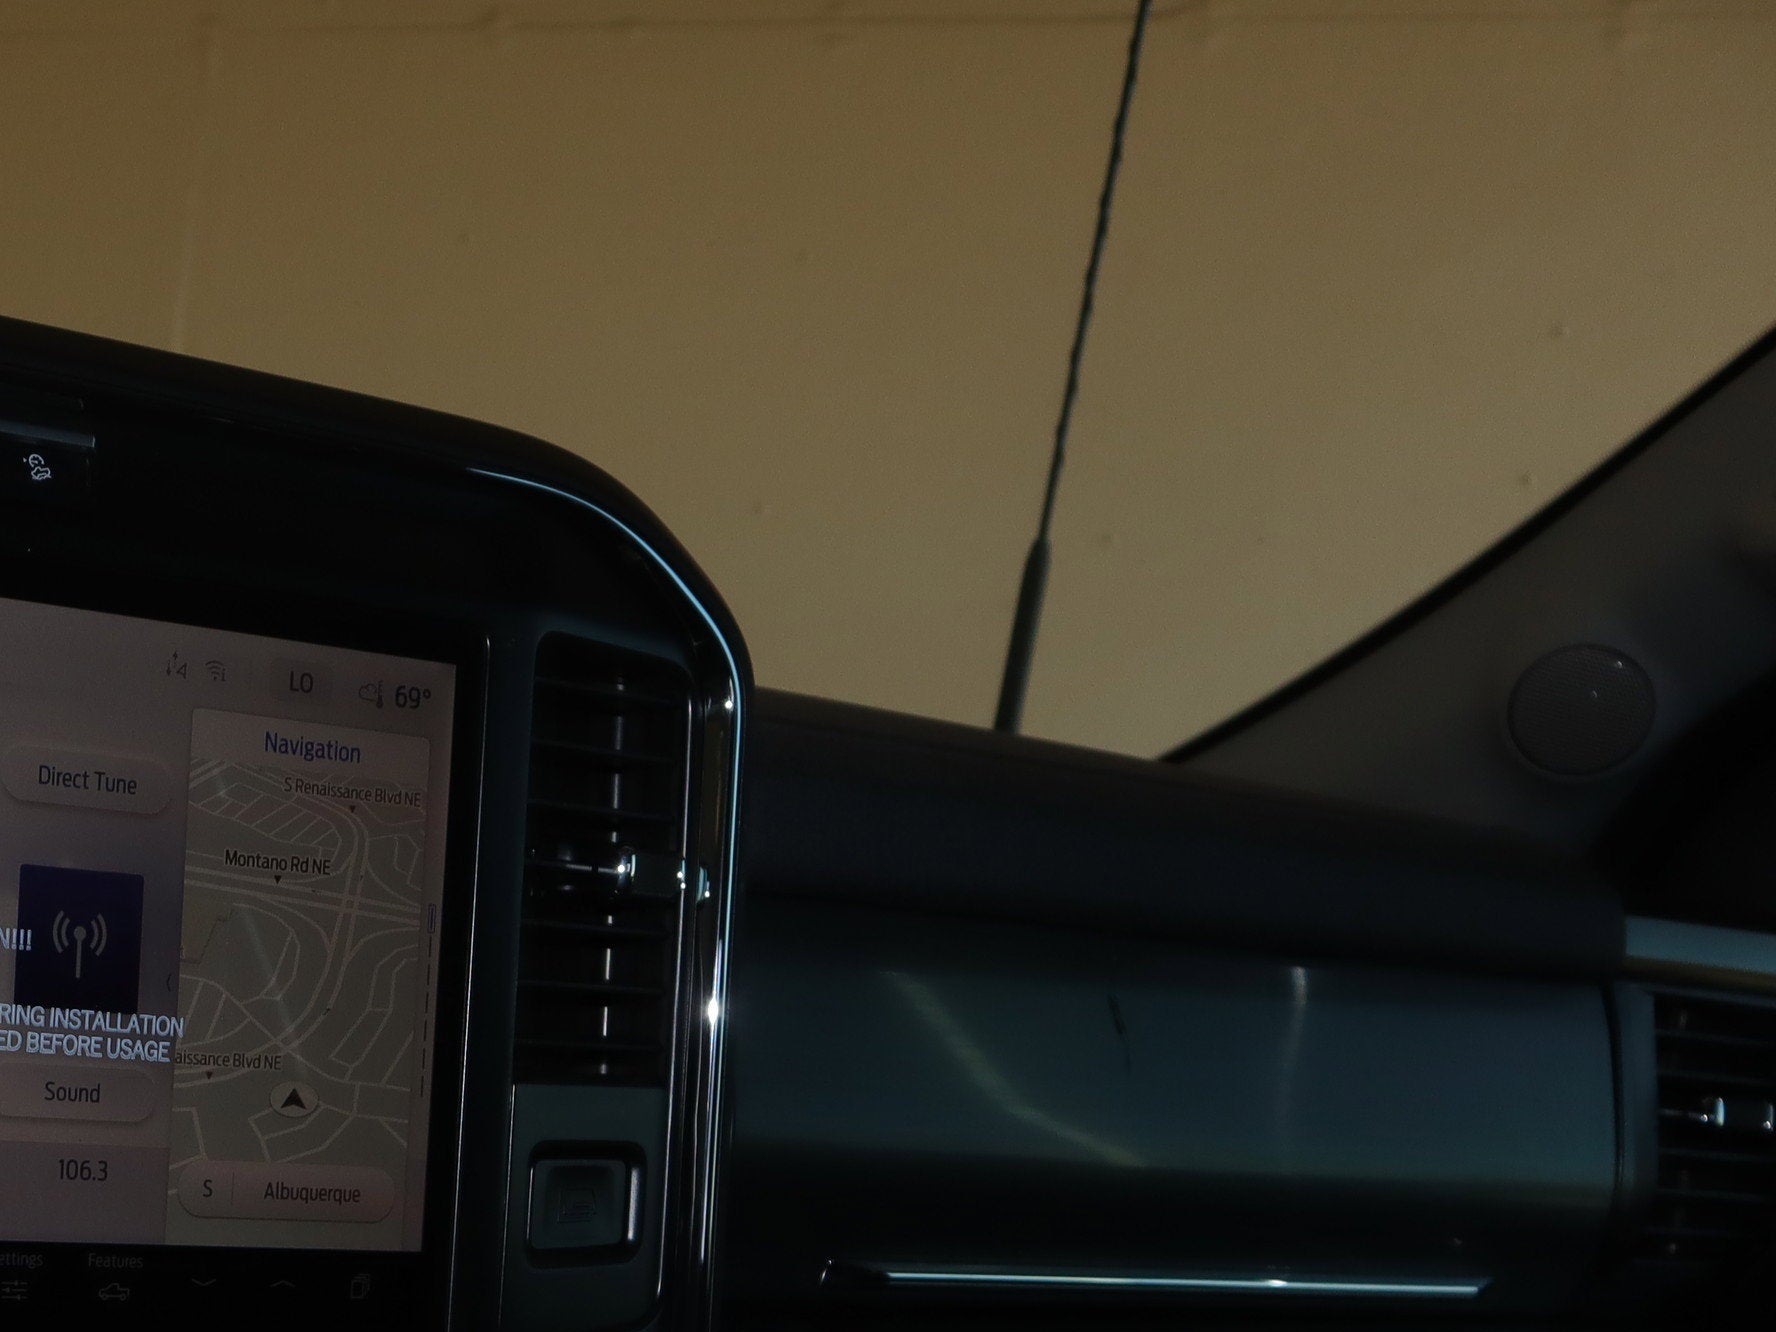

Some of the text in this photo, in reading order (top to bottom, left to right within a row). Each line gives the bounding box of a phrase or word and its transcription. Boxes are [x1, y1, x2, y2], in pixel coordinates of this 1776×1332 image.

[289, 671, 314, 693] LO
[264, 731, 361, 763] Navigation
[37, 765, 138, 795] Direct Tune
[284, 777, 421, 808] S Renaissance Blvd NE
[224, 850, 331, 875] Montano Rd NE
[49, 1007, 185, 1038] INSTALLATION
[25, 1029, 102, 1058] BEFORE
[105, 1035, 172, 1063] USAGE
[232, 1053, 262, 1069] Blvd
[263, 1055, 282, 1071] NE
[43, 1079, 102, 1104] Sound
[57, 1158, 109, 1183] 106.3
[202, 1178, 362, 1205] S Albuquerque
[87, 1252, 145, 1270] Features
